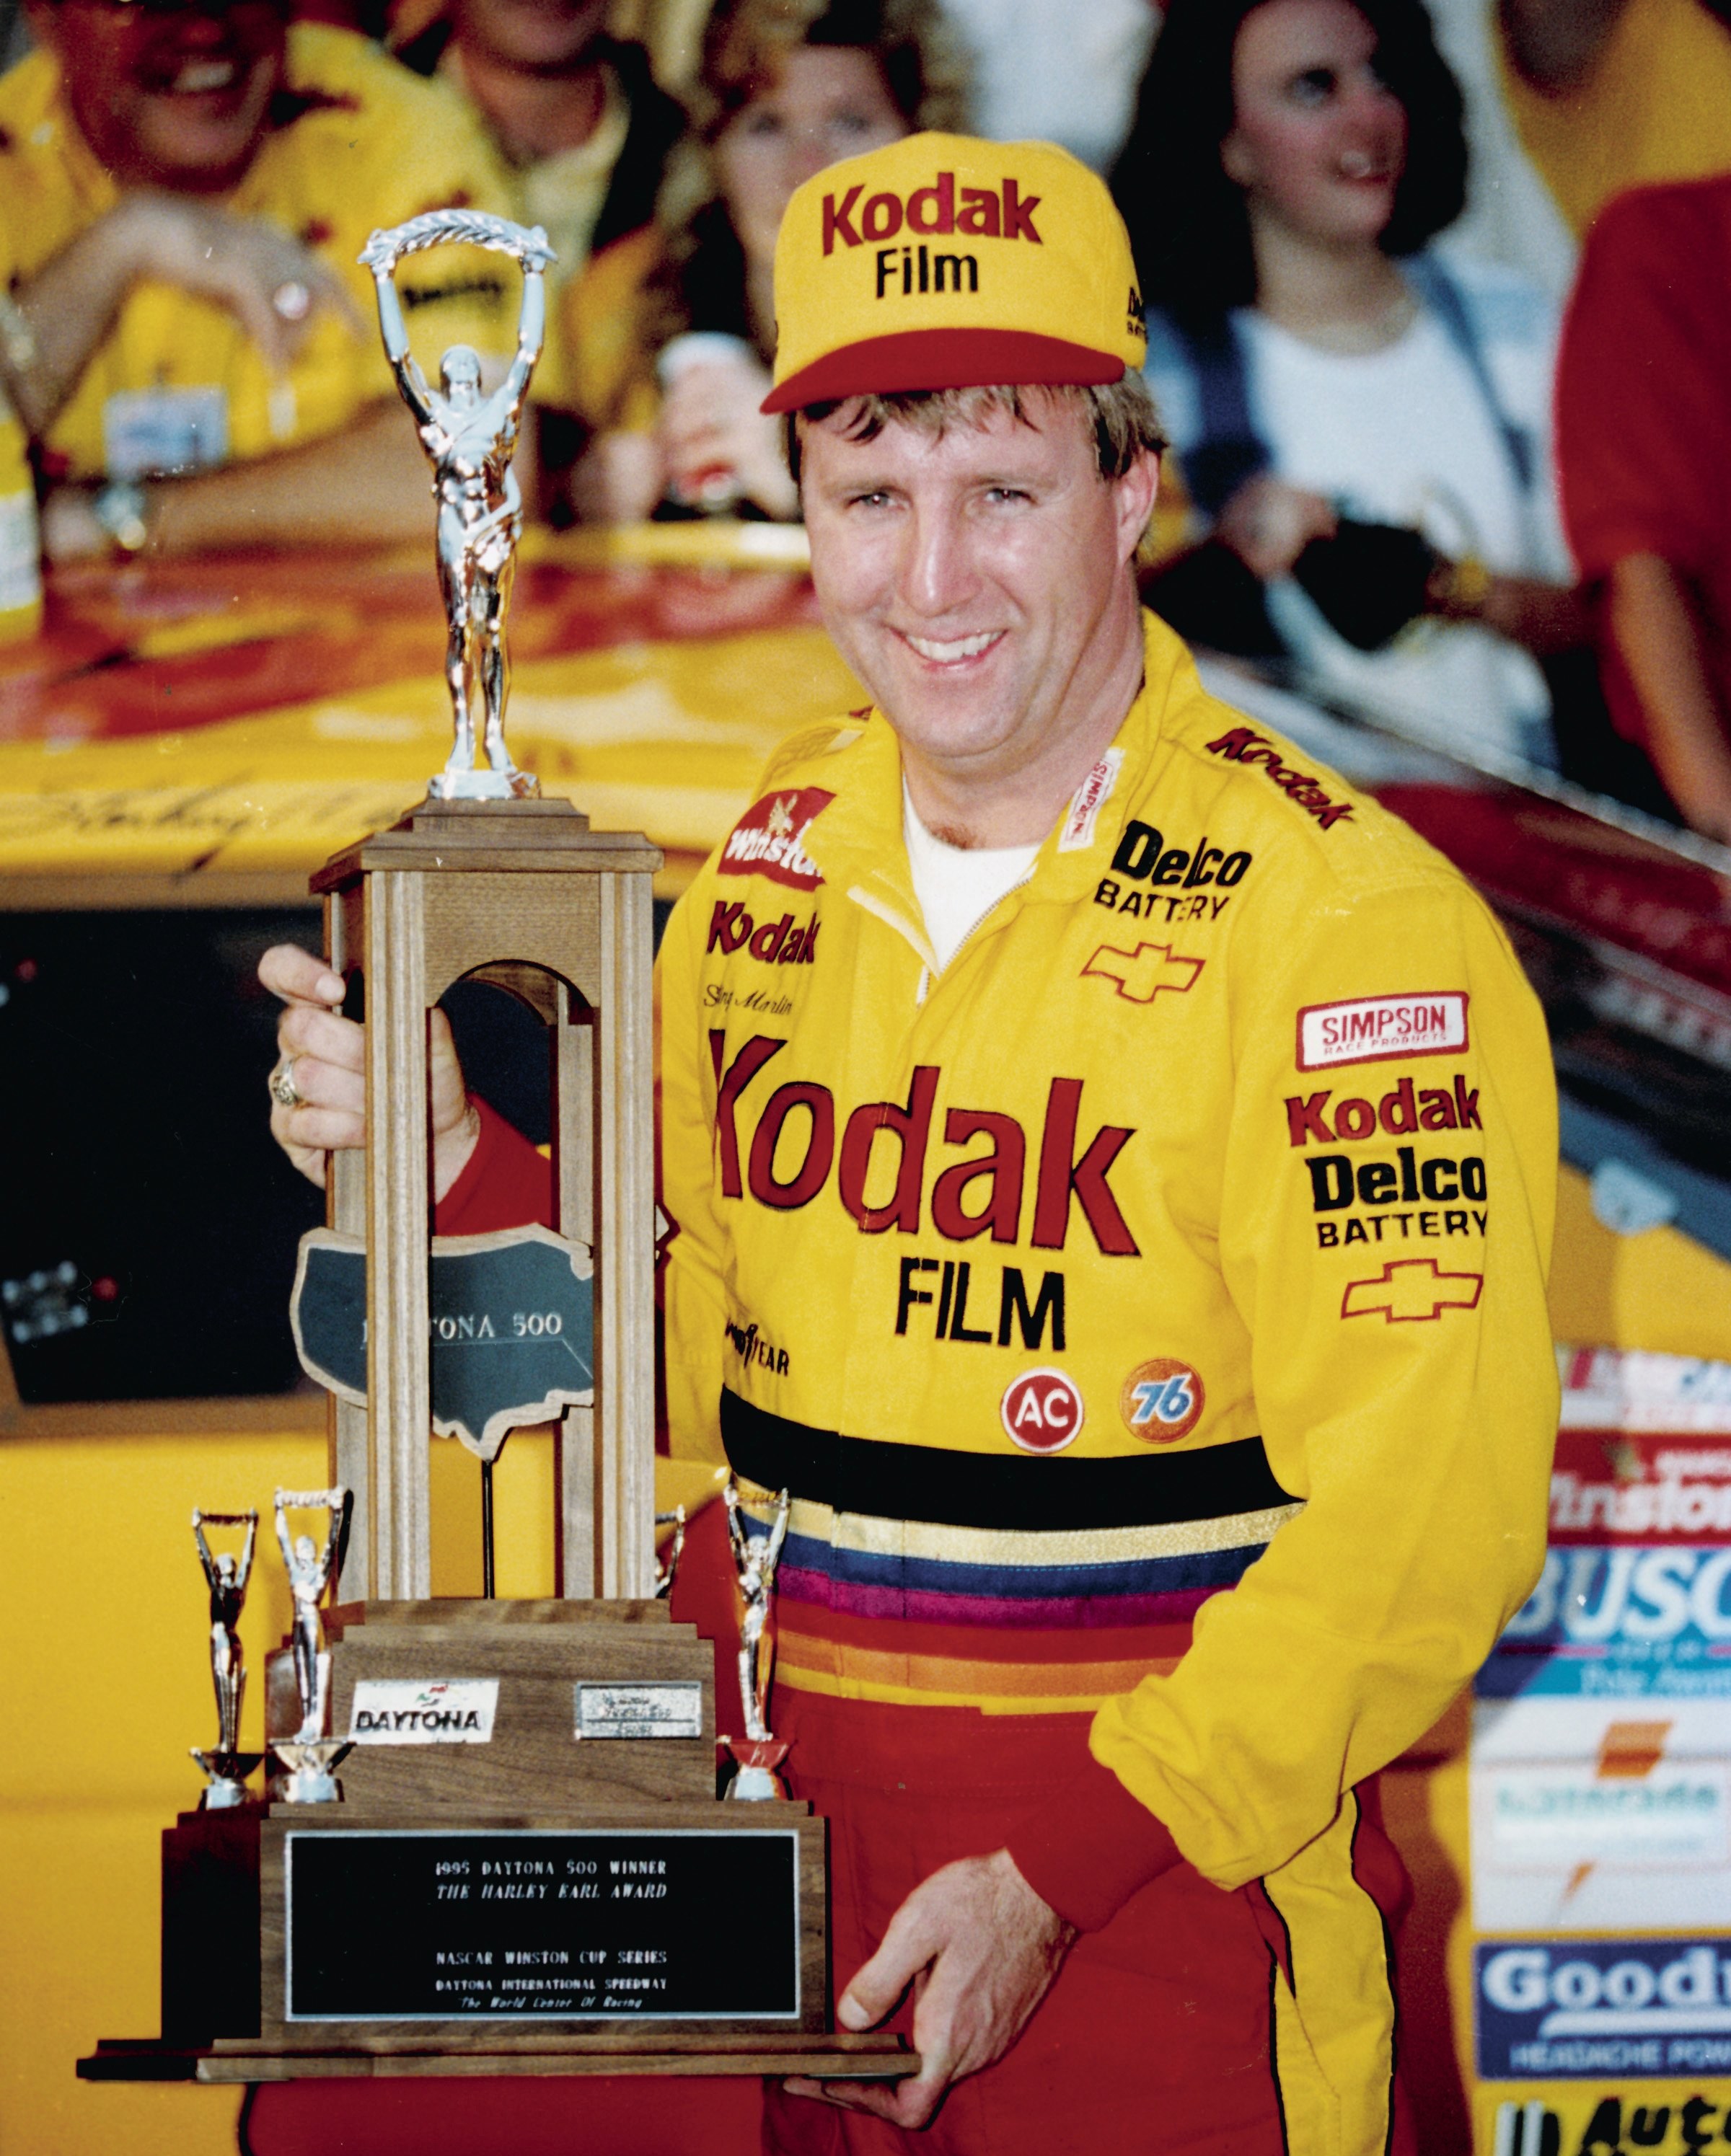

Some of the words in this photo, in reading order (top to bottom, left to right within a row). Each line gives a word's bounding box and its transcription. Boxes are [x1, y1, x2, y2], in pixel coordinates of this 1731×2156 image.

[822, 172, 1043, 257] Kodak
[876, 245, 979, 300] Film
[1205, 727, 1356, 830] Kodak
[1110, 819, 1253, 888] Delco
[706, 901, 821, 965] Kodak
[1322, 1004, 1445, 1045] SIMPSON
[1371, 1033, 1448, 1048] PRODUCTS
[1324, 1042, 1365, 1056] RACE
[1284, 1074, 1483, 1147] Kodak
[708, 1029, 1142, 1258] Kodak
[1305, 1147, 1487, 1211] Delco
[1316, 1209, 1487, 1248] BATTERY
[513, 1312, 562, 1337] 500
[894, 1256, 1066, 1351] FILM
[1015, 1387, 1069, 1429] AC
[1130, 1374, 1194, 1423] 76
[356, 1710, 480, 1731] DAYTONA
[436, 1860, 470, 1876] 1995
[482, 1860, 554, 1875] DAYTONA
[566, 1860, 597, 1875] 500
[609, 1860, 666, 1875] WINNER
[436, 1883, 470, 1899] THE
[481, 1883, 548, 1899] HARLEY
[558, 1883, 600, 1899] EARL
[611, 1882, 667, 1899] AWARD
[436, 1951, 493, 1965] NASCAR
[505, 1951, 569, 1964] WINSTON
[579, 1950, 607, 1964] CUP
[617, 1950, 667, 1963] SERIES
[436, 1979, 493, 1991] DAYTONA
[502, 1979, 596, 1991] INTERNATIONAL
[604, 1979, 667, 1990] SPEEDWAY
[1481, 1947, 1731, 2013] Good
[459, 1997, 481, 2008] The
